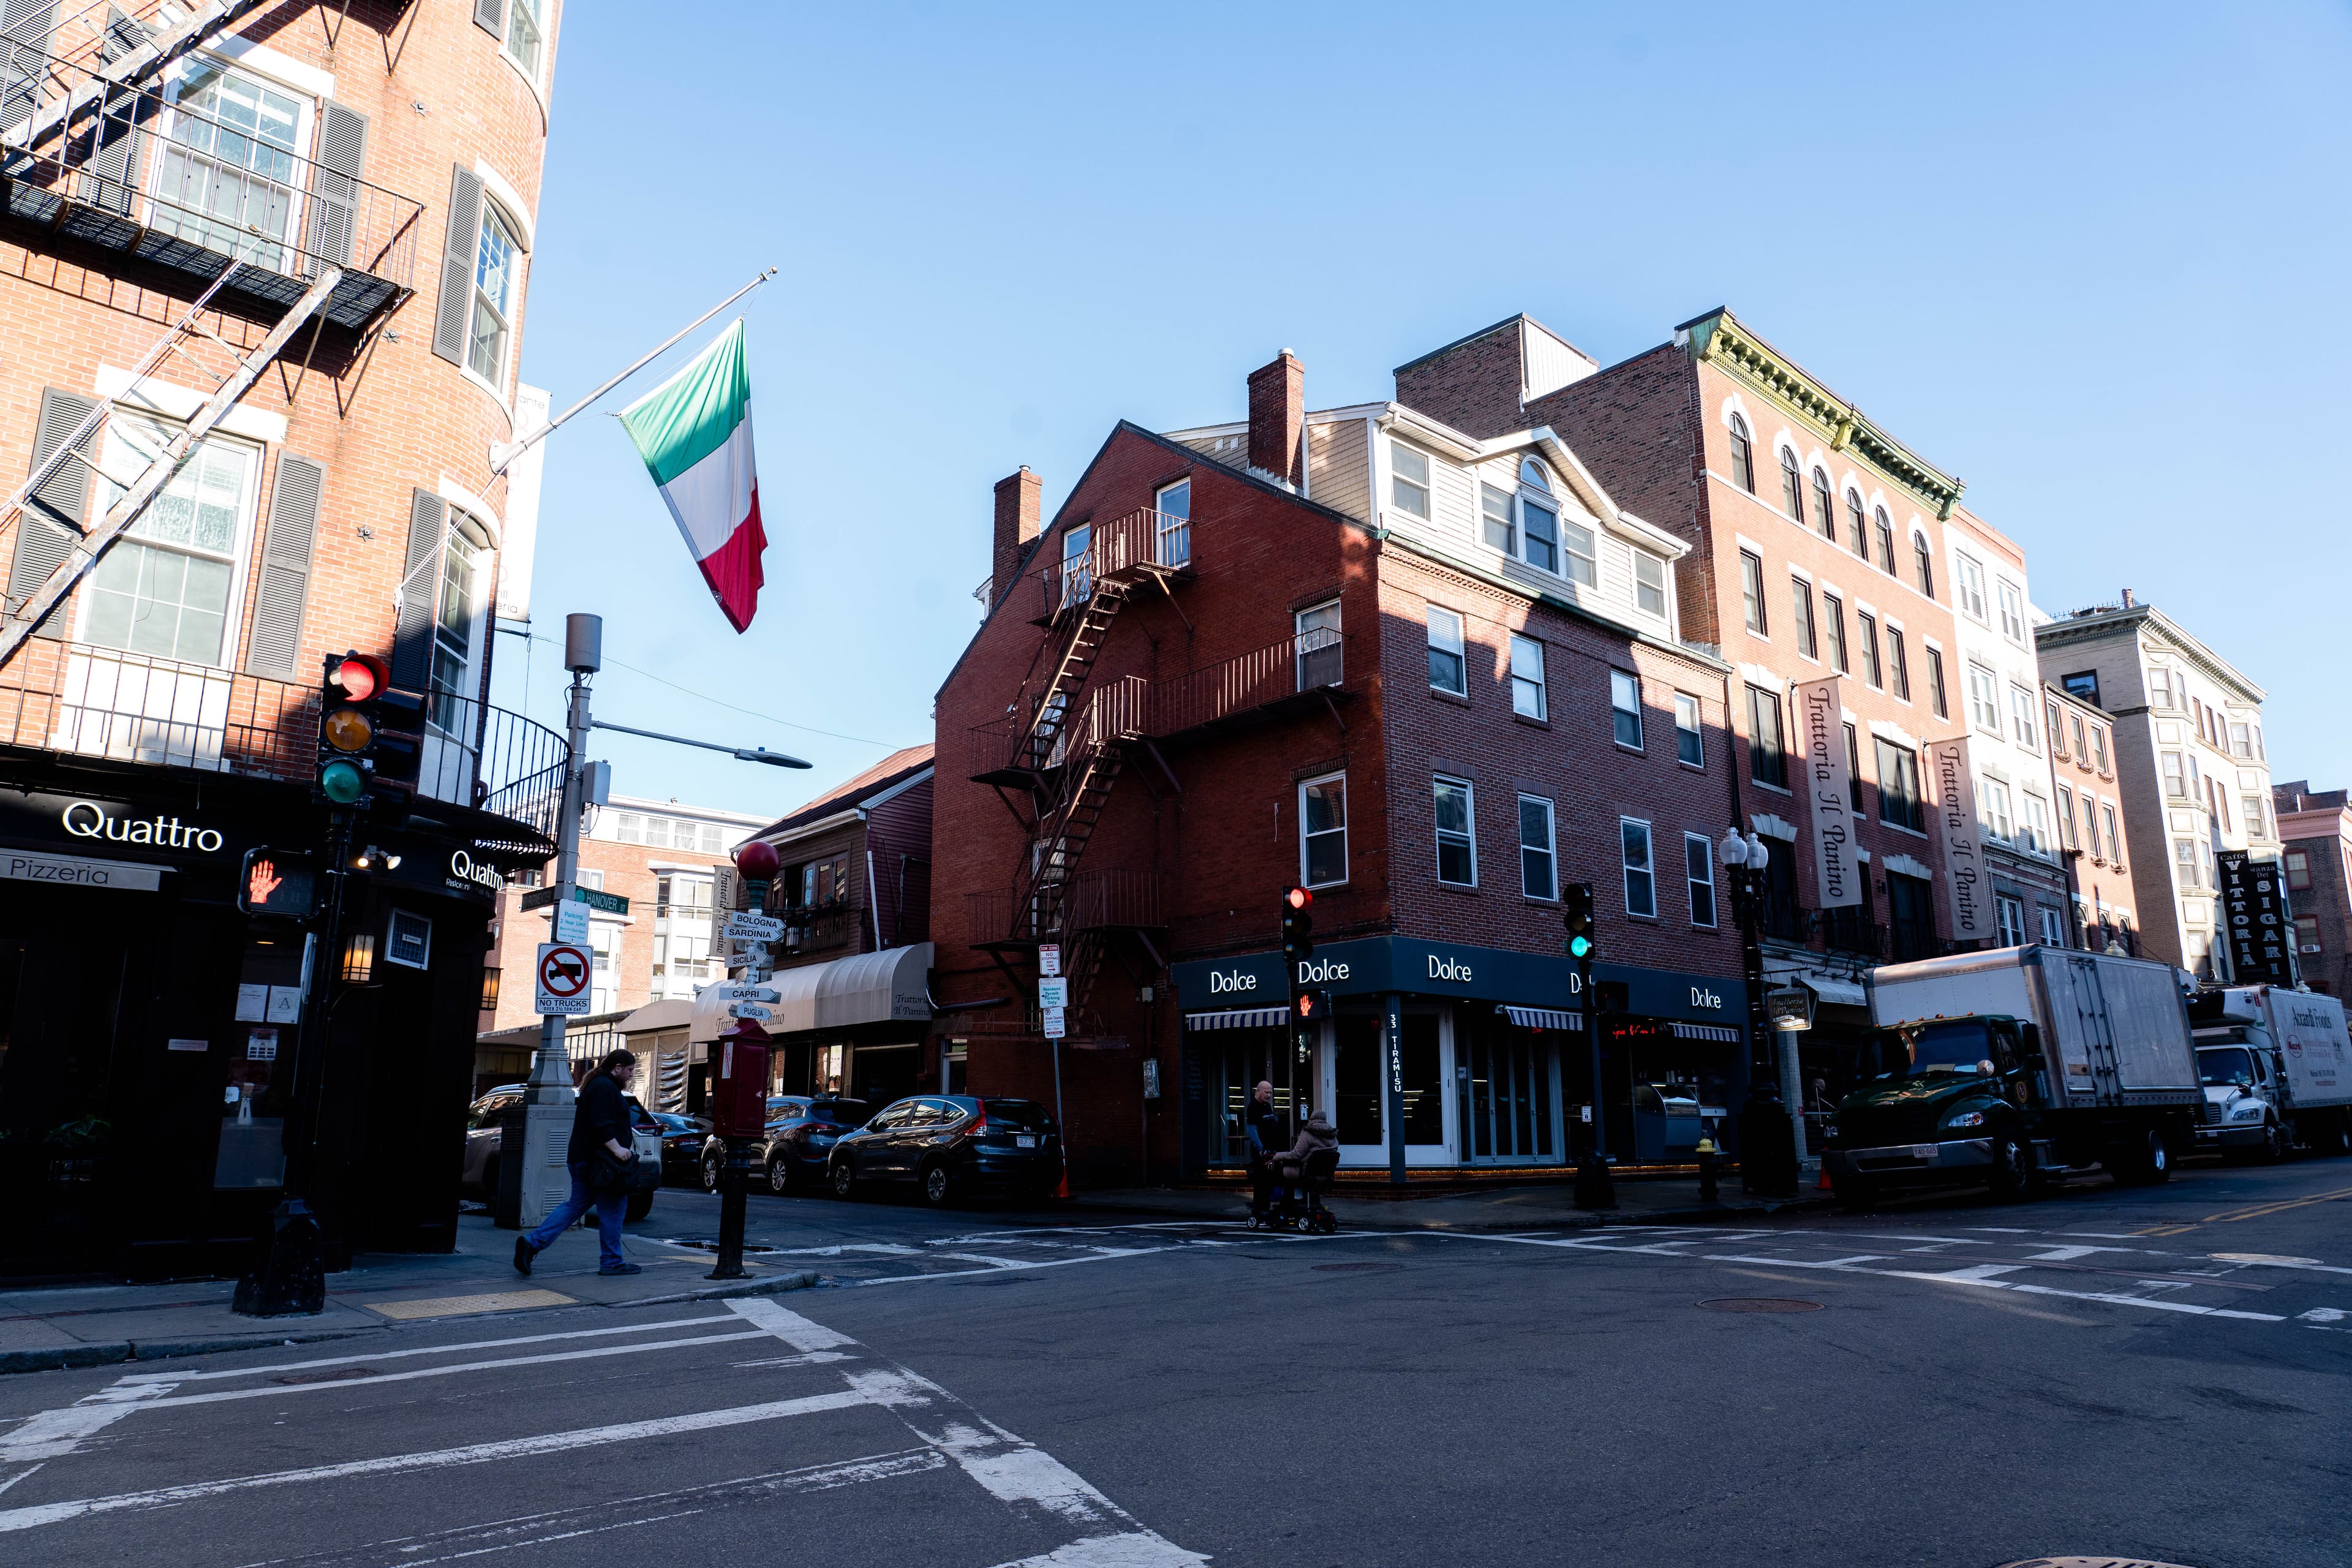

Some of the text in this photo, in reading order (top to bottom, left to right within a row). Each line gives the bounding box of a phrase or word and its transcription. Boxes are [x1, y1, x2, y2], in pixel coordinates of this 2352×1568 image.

[1807, 687, 1847, 898] Trattoria Il Panino
[62, 801, 223, 852] Quattro
[1939, 747, 1978, 930] Trattoria Il Panino
[11, 859, 108, 884] Pizzeria
[451, 850, 503, 891] Quattro
[720, 870, 731, 910] Trattoria
[586, 892, 626, 913] HANOVER ST
[2225, 860, 2256, 965] VITTORIA
[565, 911, 583, 921] Parking
[737, 915, 777, 928] BOLOGNA
[2256, 880, 2282, 974] SIGARI
[729, 929, 772, 938] SARDINIA
[733, 955, 756, 965] SICILIA
[1298, 958, 1349, 984] Dolce
[1428, 955, 1471, 981] Dolce
[1211, 969, 1256, 993] Dolce
[278, 997, 290, 1009] A
[895, 992, 930, 1004] Trattoria
[1691, 987, 1721, 1009] Dolce
[744, 1007, 764, 1017] PUGLIA
[903, 1006, 930, 1016] Panino
[1390, 1014, 1401, 1092] 33 TIRAMISU
